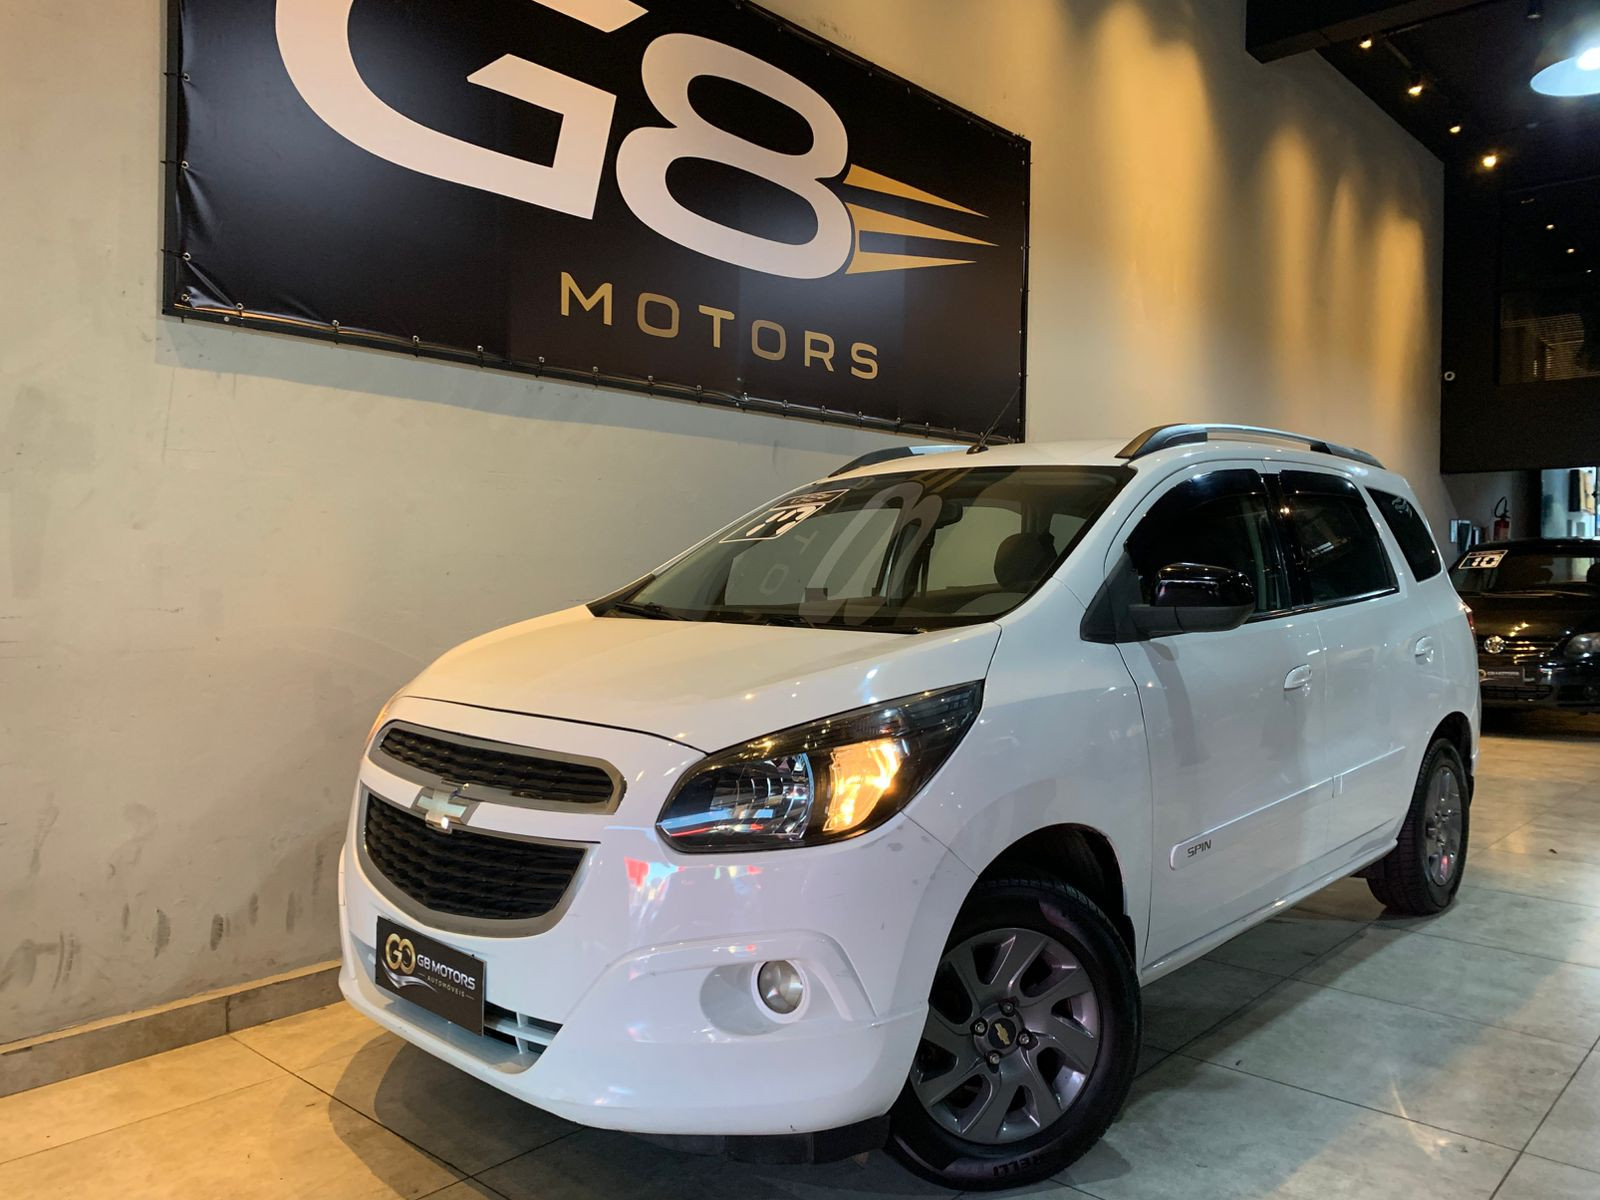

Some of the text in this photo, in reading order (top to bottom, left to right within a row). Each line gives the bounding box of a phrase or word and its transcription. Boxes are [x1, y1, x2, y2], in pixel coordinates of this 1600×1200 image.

[275, 0, 854, 280] G8
[560, 271, 879, 381] MOTORS
[1187, 839, 1212, 858] SPIN
[431, 960, 476, 991] MOTORS
